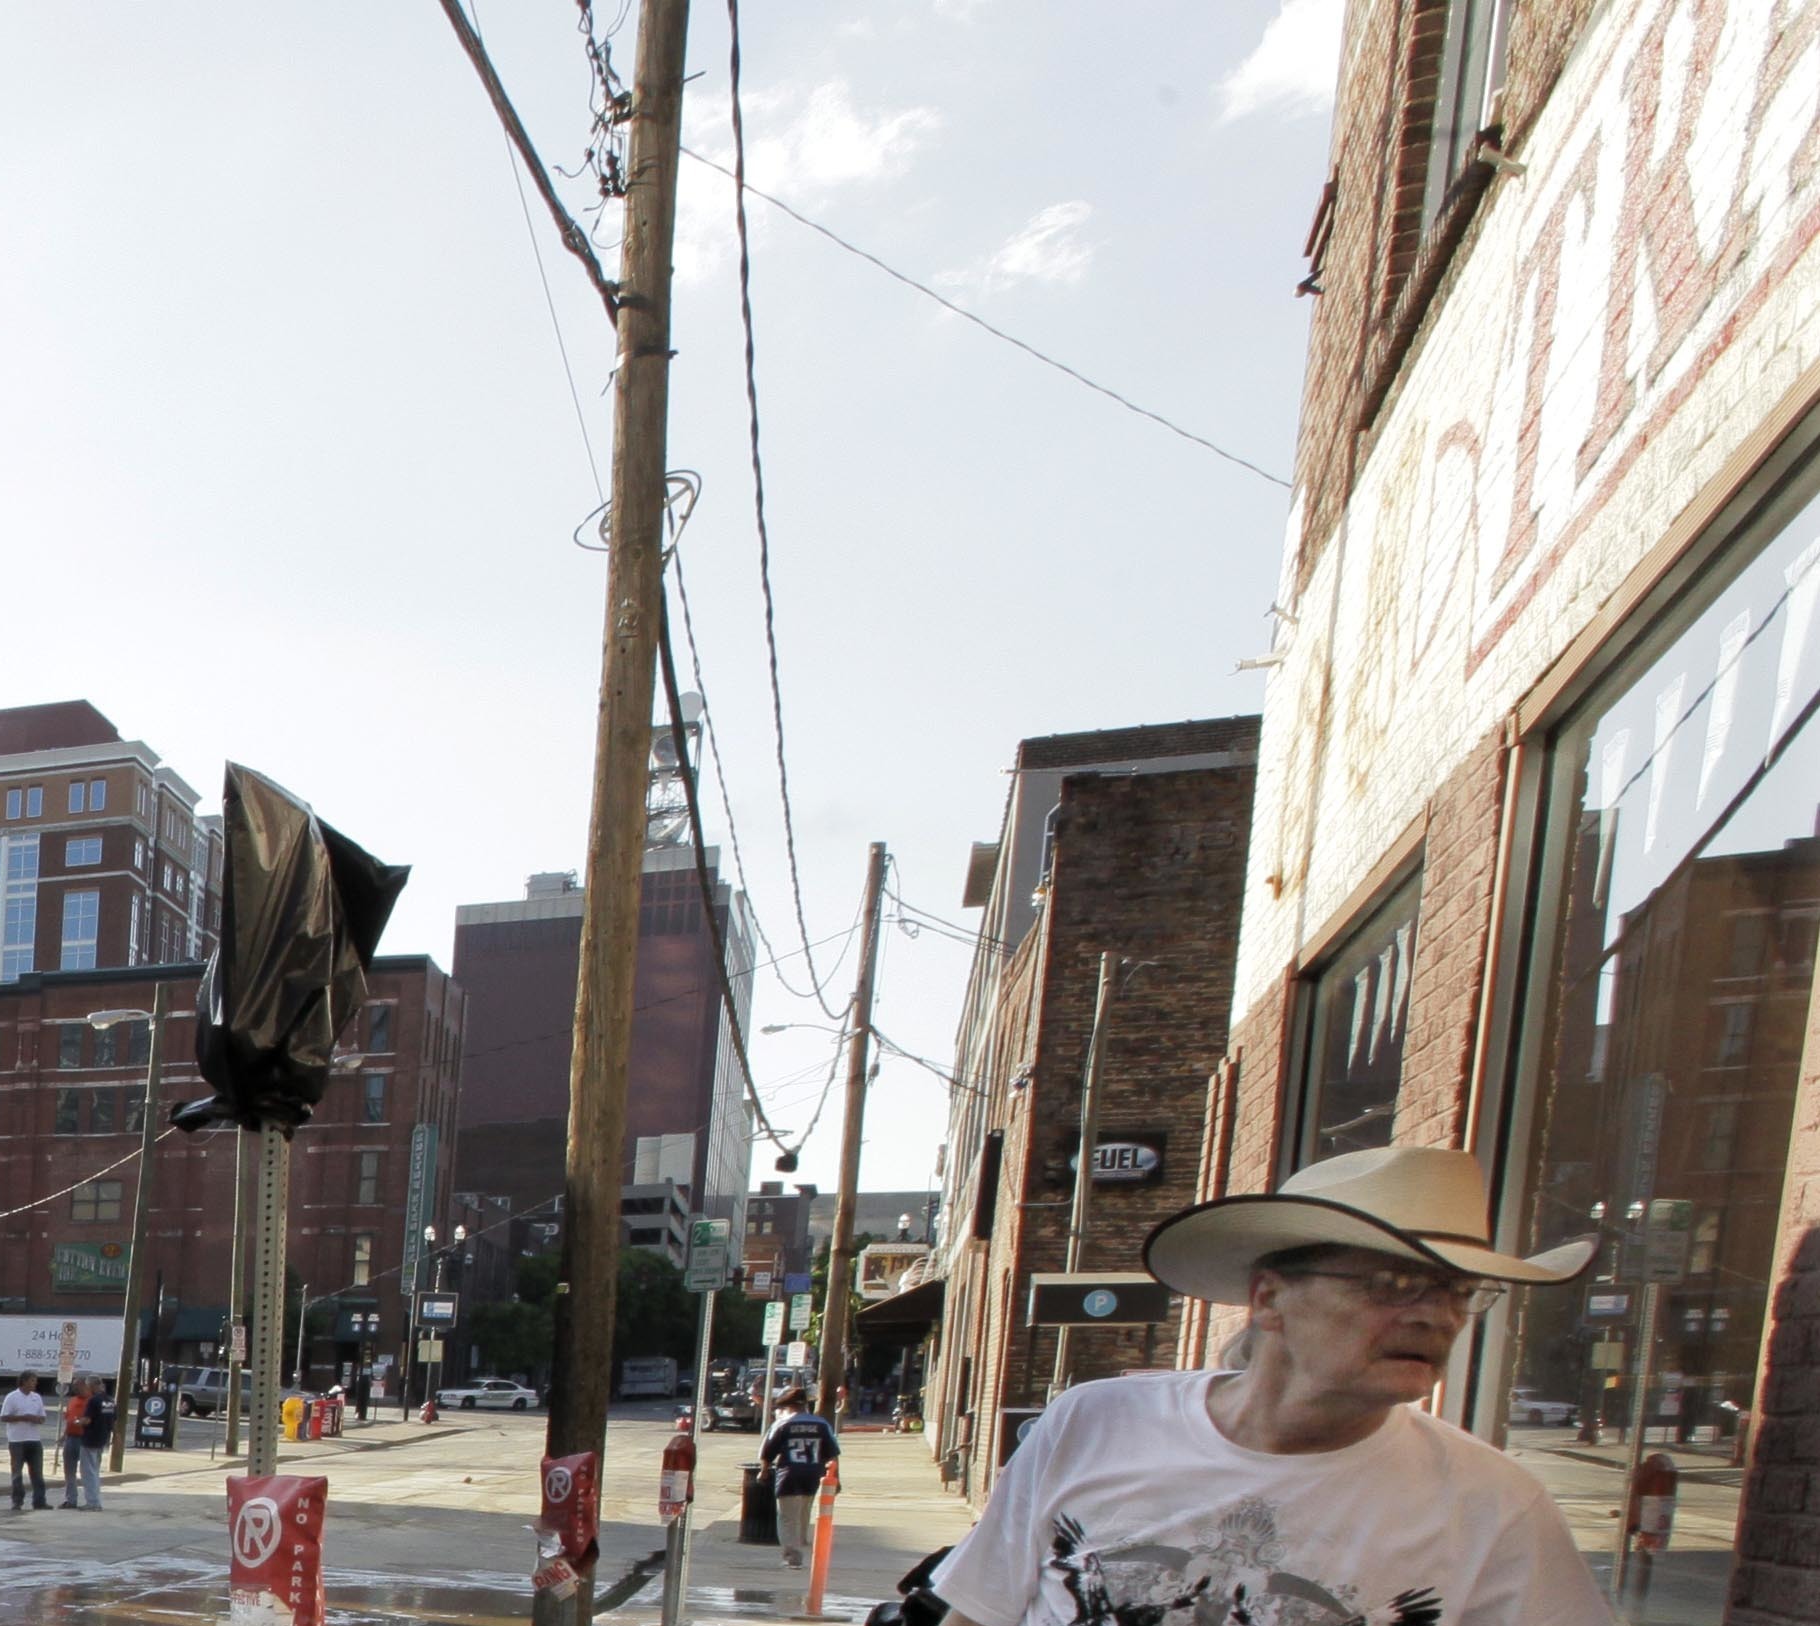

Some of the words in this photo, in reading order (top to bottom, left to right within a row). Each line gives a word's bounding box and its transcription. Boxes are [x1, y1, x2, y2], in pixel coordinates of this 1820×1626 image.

[31, 1330, 46, 1341] 24
[787, 1438, 821, 1464] 27
[295, 1496, 310, 1525] NO
